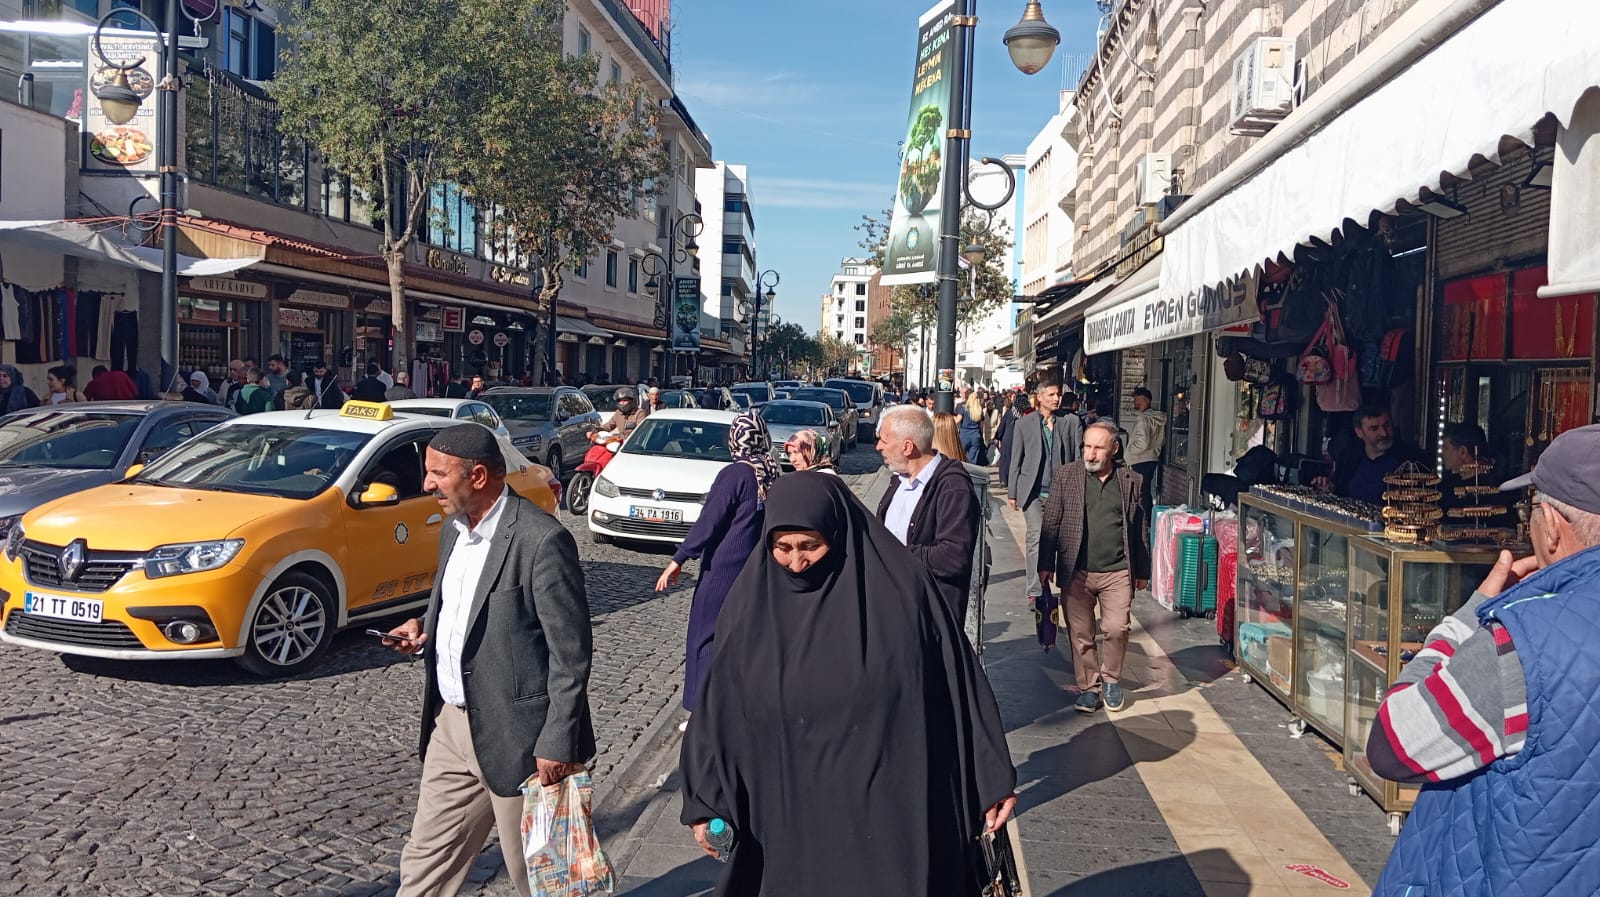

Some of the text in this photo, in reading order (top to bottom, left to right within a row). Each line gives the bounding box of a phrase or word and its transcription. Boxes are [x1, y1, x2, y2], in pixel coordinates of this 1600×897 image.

[1113, 307, 1135, 344] ÇANTA
[1144, 296, 1183, 330] EYMEN
[635, 508, 645, 519] 34
[661, 510, 680, 520] 1916
[32, 596, 100, 619] 21 TT 0519
